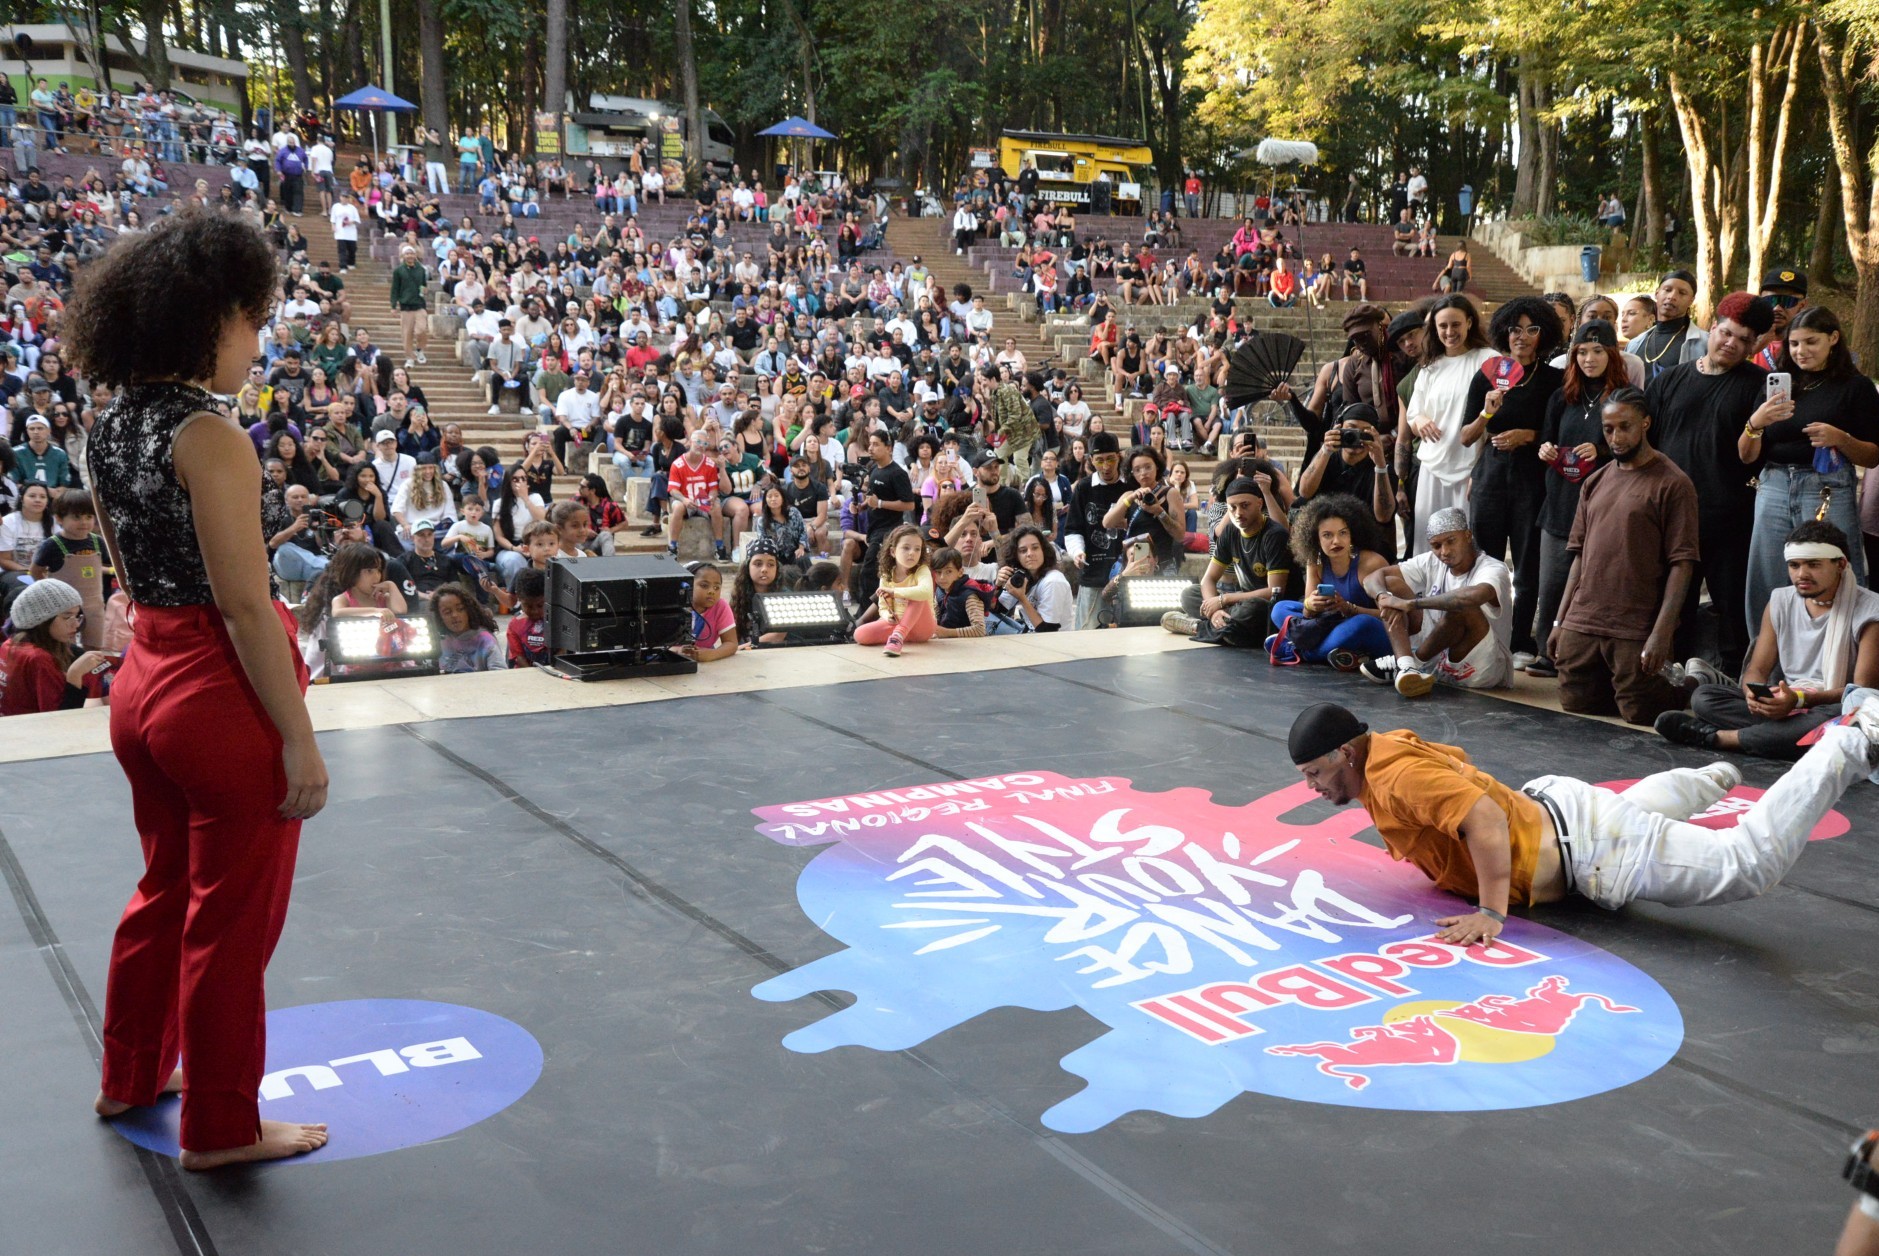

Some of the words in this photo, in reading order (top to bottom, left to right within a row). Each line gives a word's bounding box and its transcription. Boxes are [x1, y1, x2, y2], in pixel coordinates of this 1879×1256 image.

[1030, 141, 1067, 150] FIREBULL
[1038, 190, 1090, 203] FIREBULL
[1496, 378, 1510, 386] RED
[731, 468, 755, 493] 10
[782, 774, 1045, 817] CAMPINAS
[1004, 780, 1117, 804] FINAL
[769, 798, 993, 839] REGIONAL
[1055, 869, 1414, 989] DANCE
[1314, 935, 1548, 996] Red
[1131, 964, 1379, 1044] Bull
[257, 1036, 483, 1103] BLU
